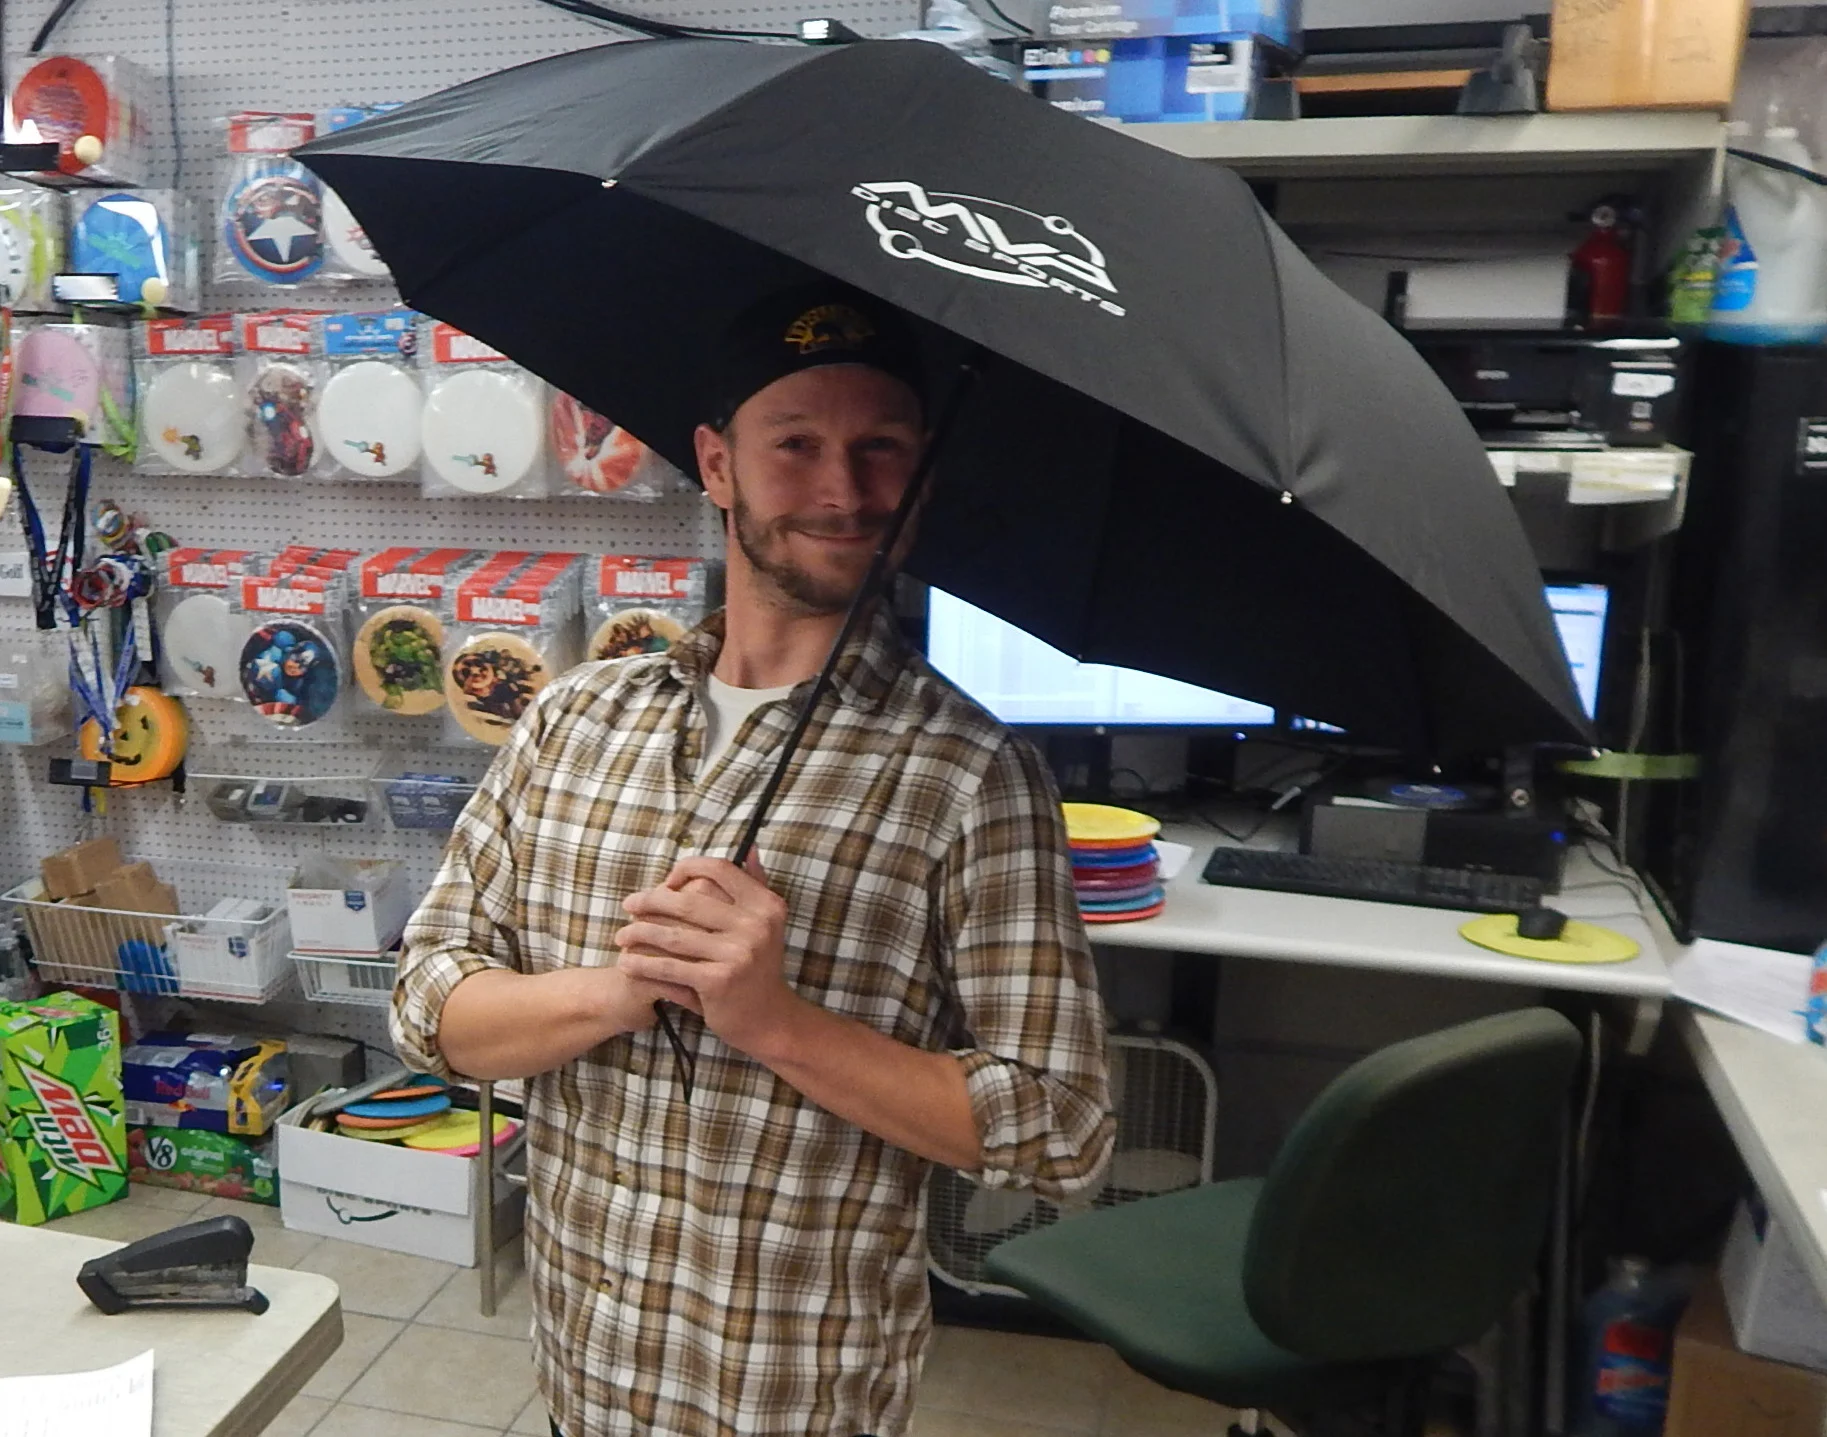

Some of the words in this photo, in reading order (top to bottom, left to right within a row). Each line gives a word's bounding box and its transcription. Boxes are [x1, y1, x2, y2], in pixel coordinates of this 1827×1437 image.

[850, 186, 950, 235] DISC
[963, 237, 1127, 317] SPORTS
[148, 1137, 173, 1167] V8
